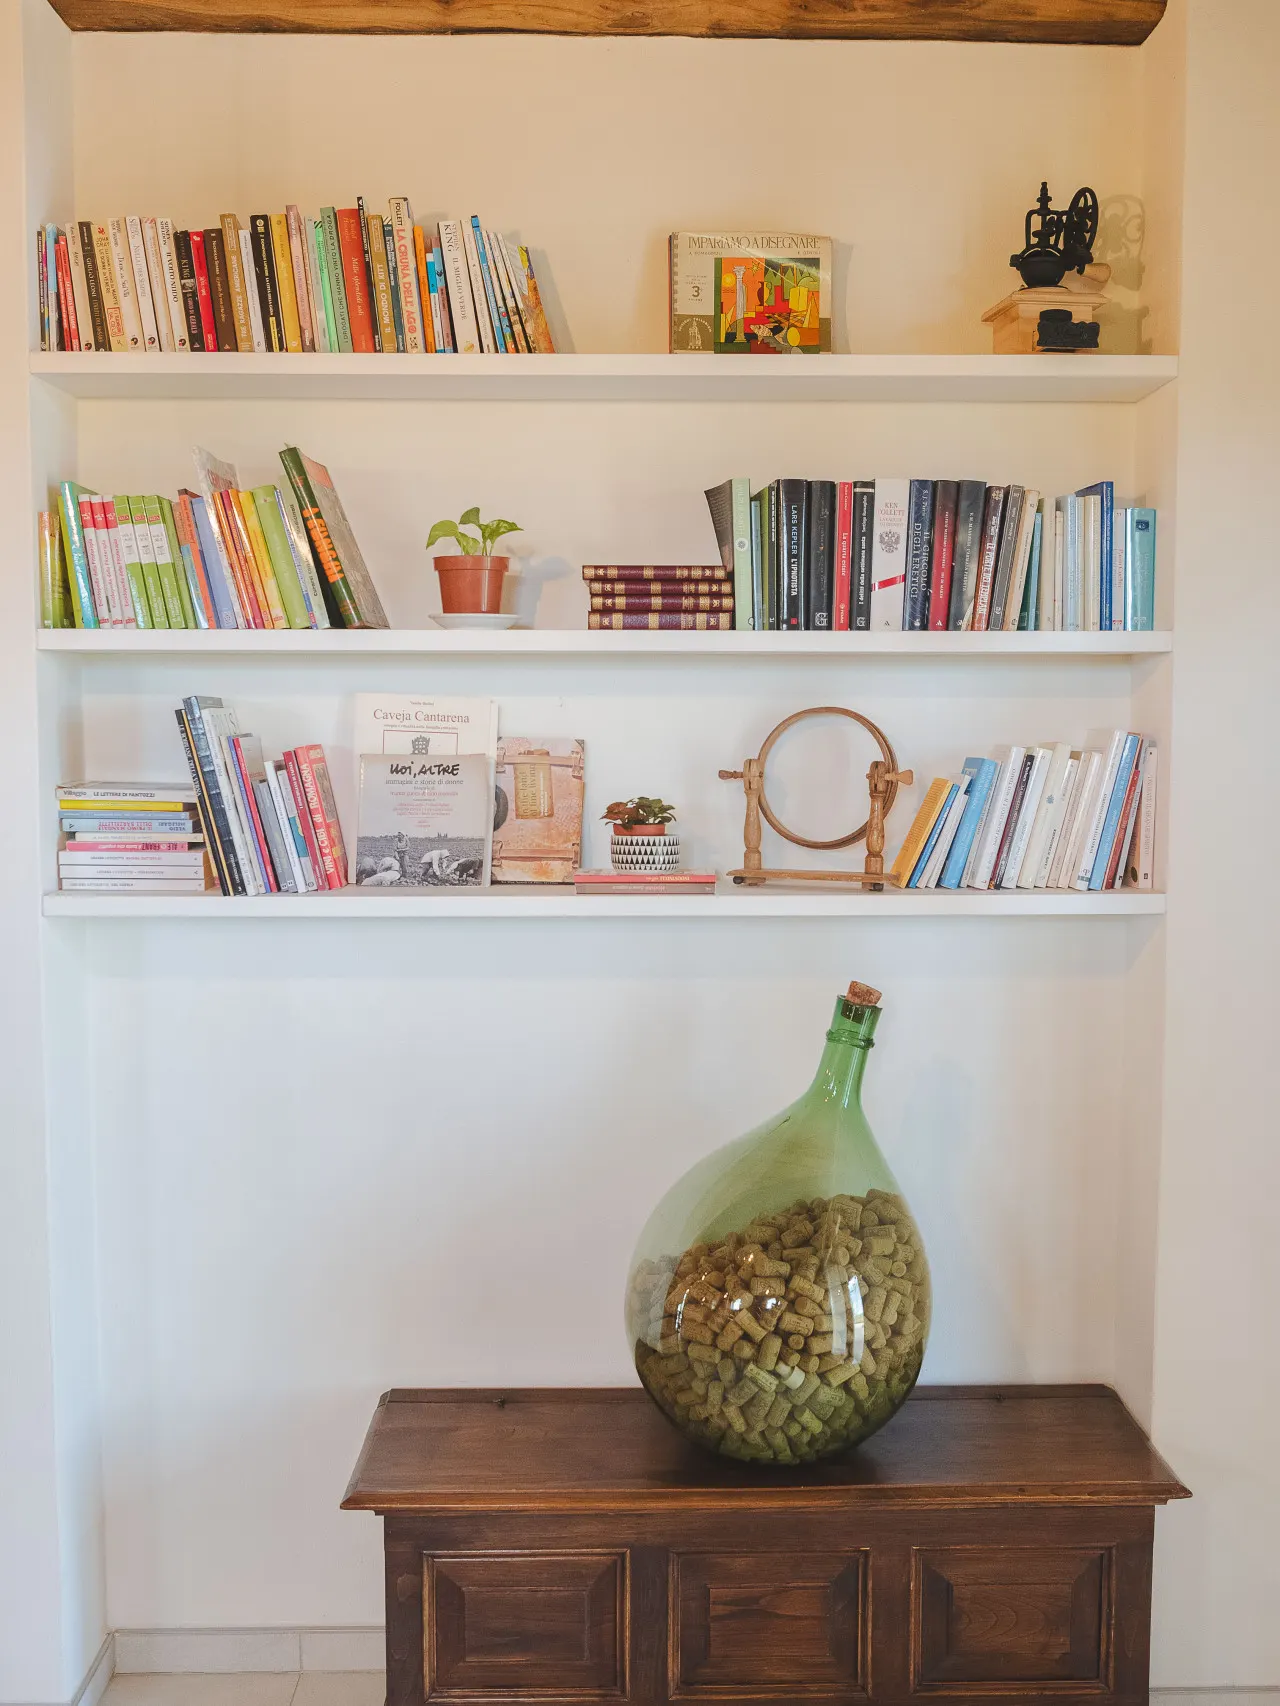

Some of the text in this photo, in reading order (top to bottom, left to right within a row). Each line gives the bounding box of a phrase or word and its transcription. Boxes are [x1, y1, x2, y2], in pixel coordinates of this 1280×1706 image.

[395, 203, 403, 226] FOLLETT
[396, 228, 406, 242] LA
[444, 224, 454, 252] KING
[688, 237, 820, 248] IMPARIAMO A DISEGNARE
[181, 259, 190, 278] KING
[351, 257, 359, 273] Mille
[376, 263, 385, 279] KITT
[398, 244, 410, 279] CRUNA
[230, 255, 242, 292] AMERICANE
[326, 215, 349, 339] DROGATI CHE HANNO VINTO LA DROGA
[353, 275, 362, 303] splendidi
[379, 282, 386, 290] DI
[452, 257, 467, 320] IL MIGLIO VERDE
[236, 296, 246, 324] RAGAZZE
[380, 293, 390, 323] MONDO
[406, 310, 417, 334] AGO
[307, 518, 345, 584] FUNGHI
[910, 523, 921, 598] DEGLI ERETICI
[920, 531, 930, 591] IL CIRCOLO
[308, 575, 318, 597] Curarsi
[790, 558, 798, 596] L'IPNOTISTA
[373, 708, 470, 723] Caveja Cantarena
[417, 763, 460, 776] ALTRE
[301, 763, 318, 808] ROMAGNA
[314, 814, 323, 823] di
[141, 842, 178, 851] ALE FRANZ
[317, 828, 328, 846] CIBI
[320, 855, 335, 874] VINI
